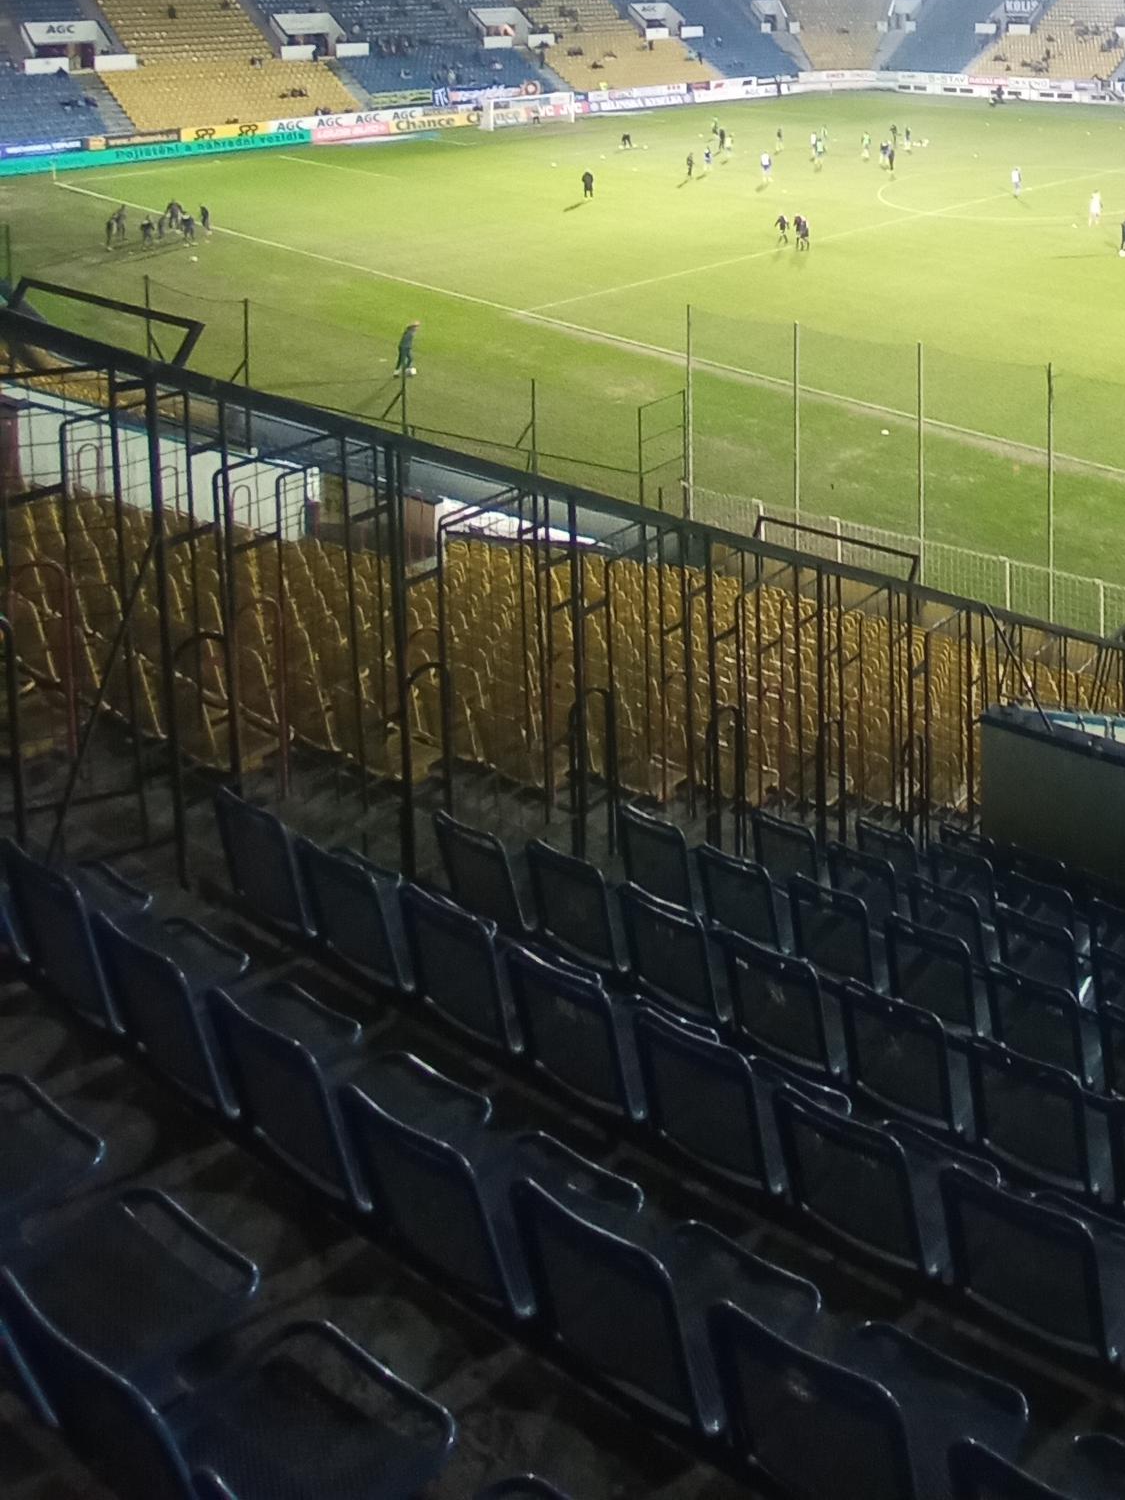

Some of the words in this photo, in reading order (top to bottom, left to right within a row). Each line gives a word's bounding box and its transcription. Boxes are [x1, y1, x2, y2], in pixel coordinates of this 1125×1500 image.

[46, 24, 76, 34] AGC
[276, 120, 304, 133] AGC
[316, 116, 344, 128] AGC
[355, 112, 381, 124] AGC
[392, 109, 417, 121] AGC
[395, 116, 455, 132] Chance
